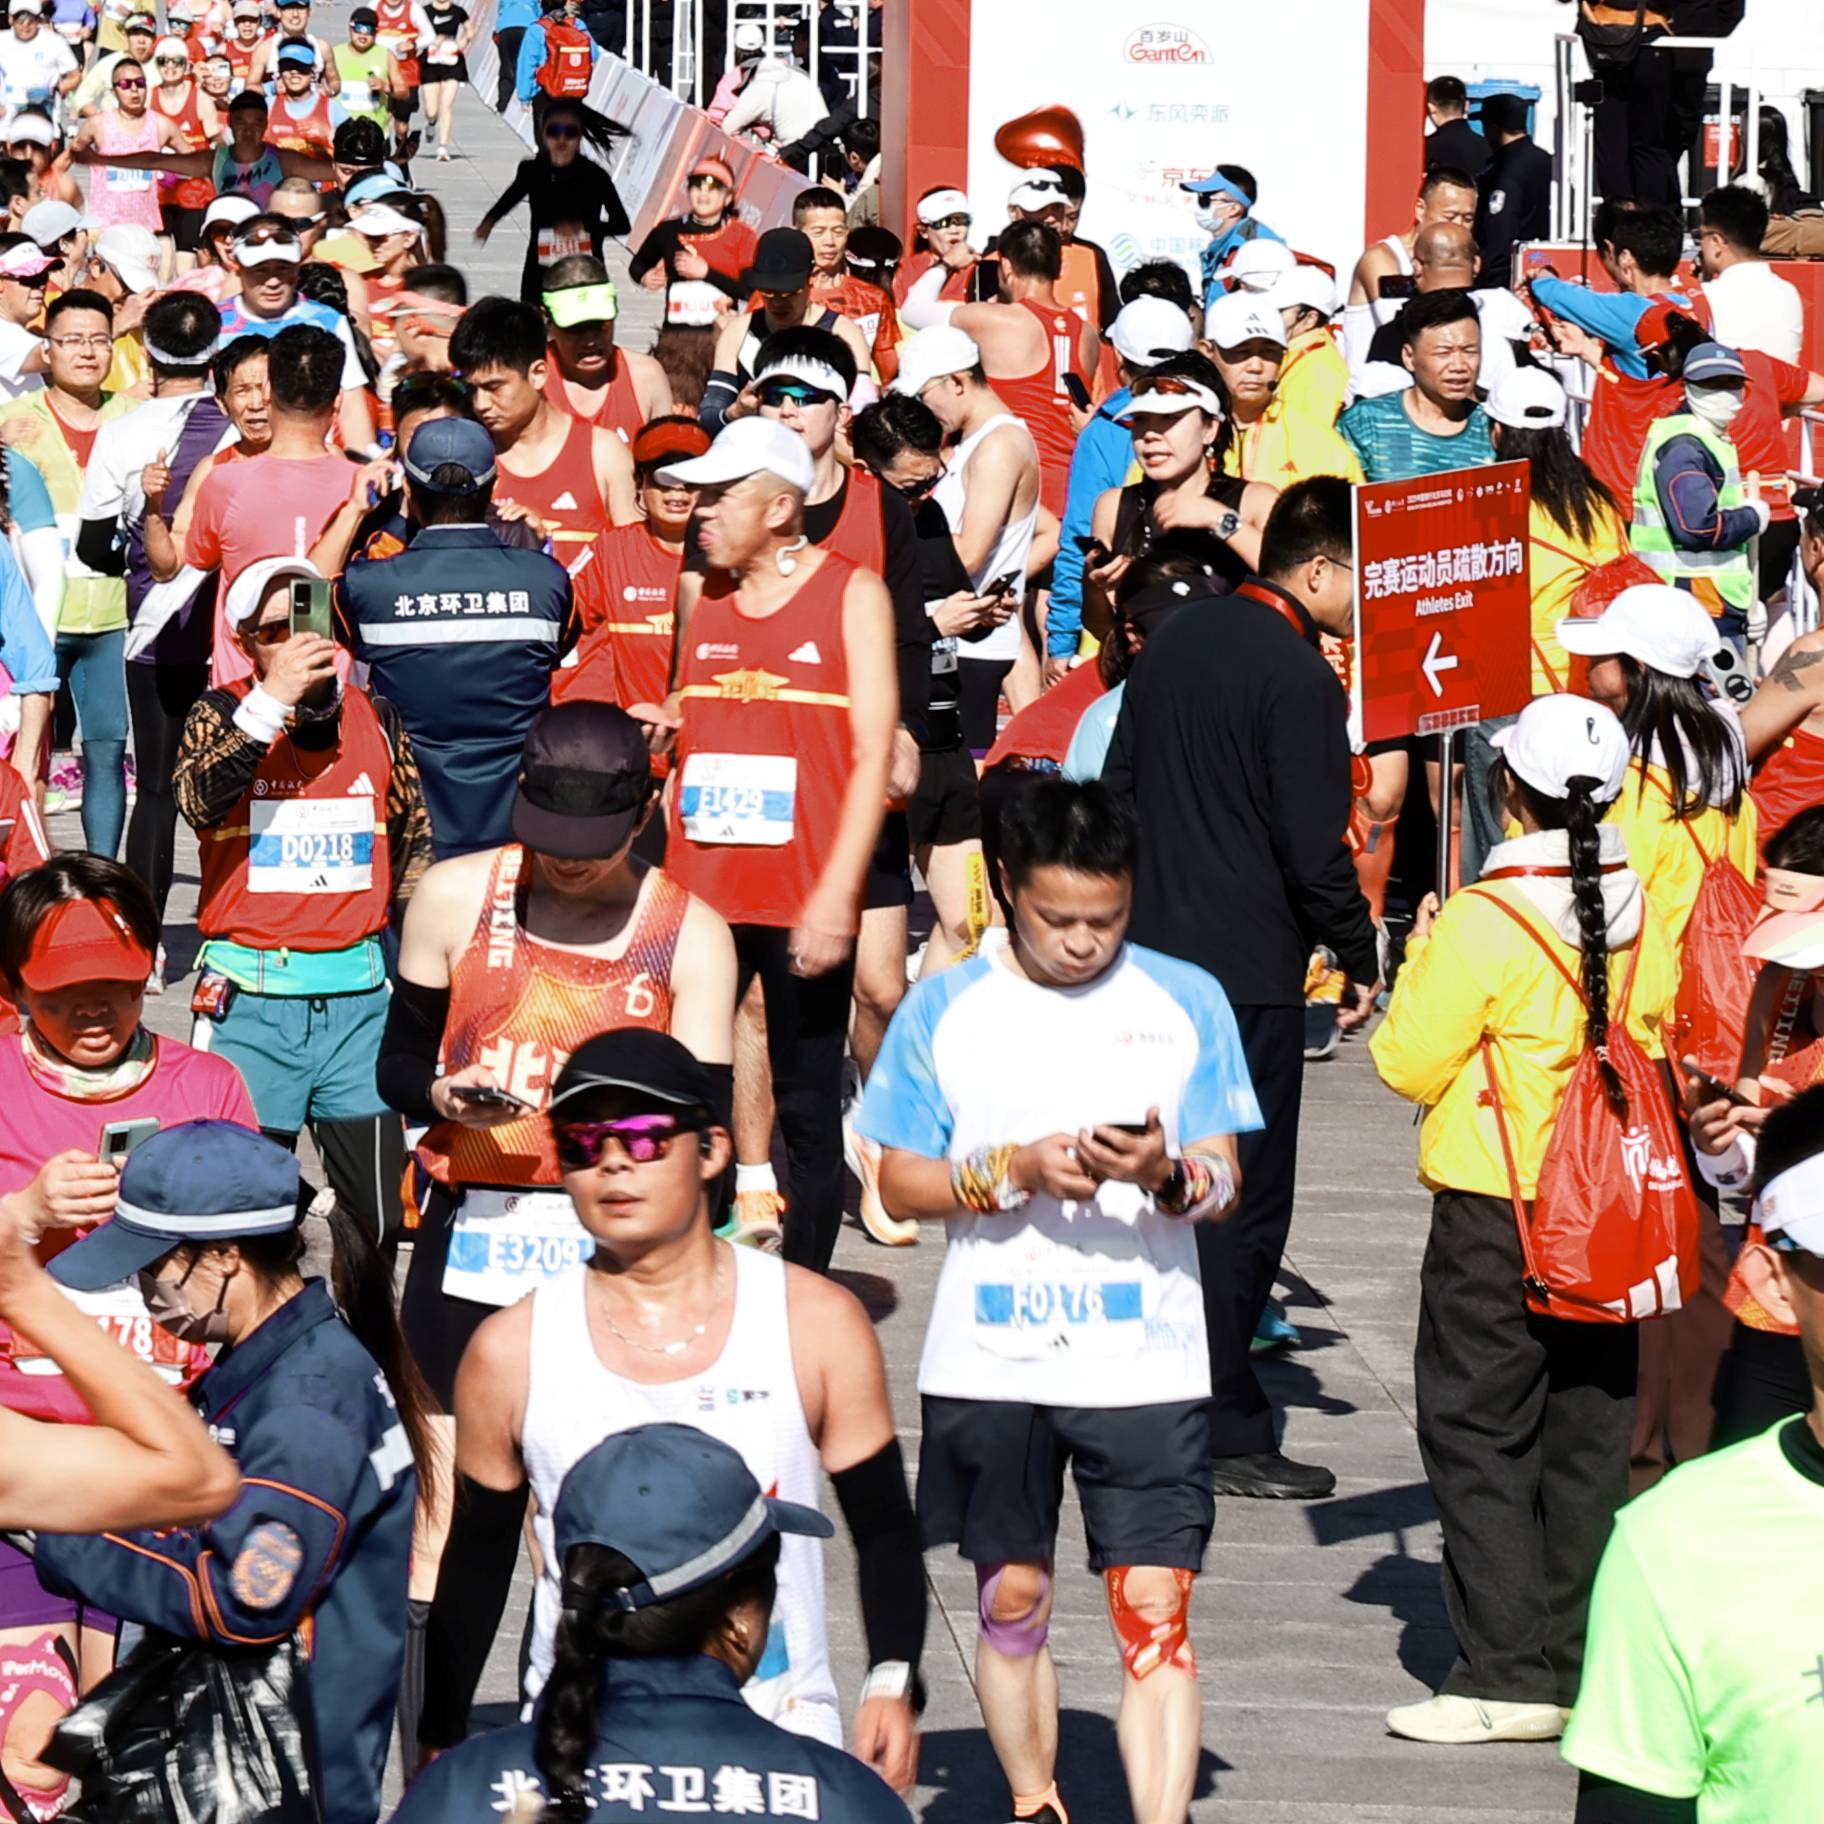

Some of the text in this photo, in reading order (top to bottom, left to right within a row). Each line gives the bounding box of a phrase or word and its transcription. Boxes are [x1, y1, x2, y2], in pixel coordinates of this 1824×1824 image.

[1139, 30, 1189, 43] 百岁山
[1364, 536, 1524, 601] 完赛运动员疏散方向
[394, 589, 531, 618] 北京环卫集团
[1415, 590, 1474, 617] Athletes Exit
[699, 786, 763, 814] E1429
[281, 832, 354, 862] D0218
[488, 843, 525, 969] BEIJING
[487, 1232, 581, 1271] E3209
[491, 1764, 820, 1821] 北环卫集团
